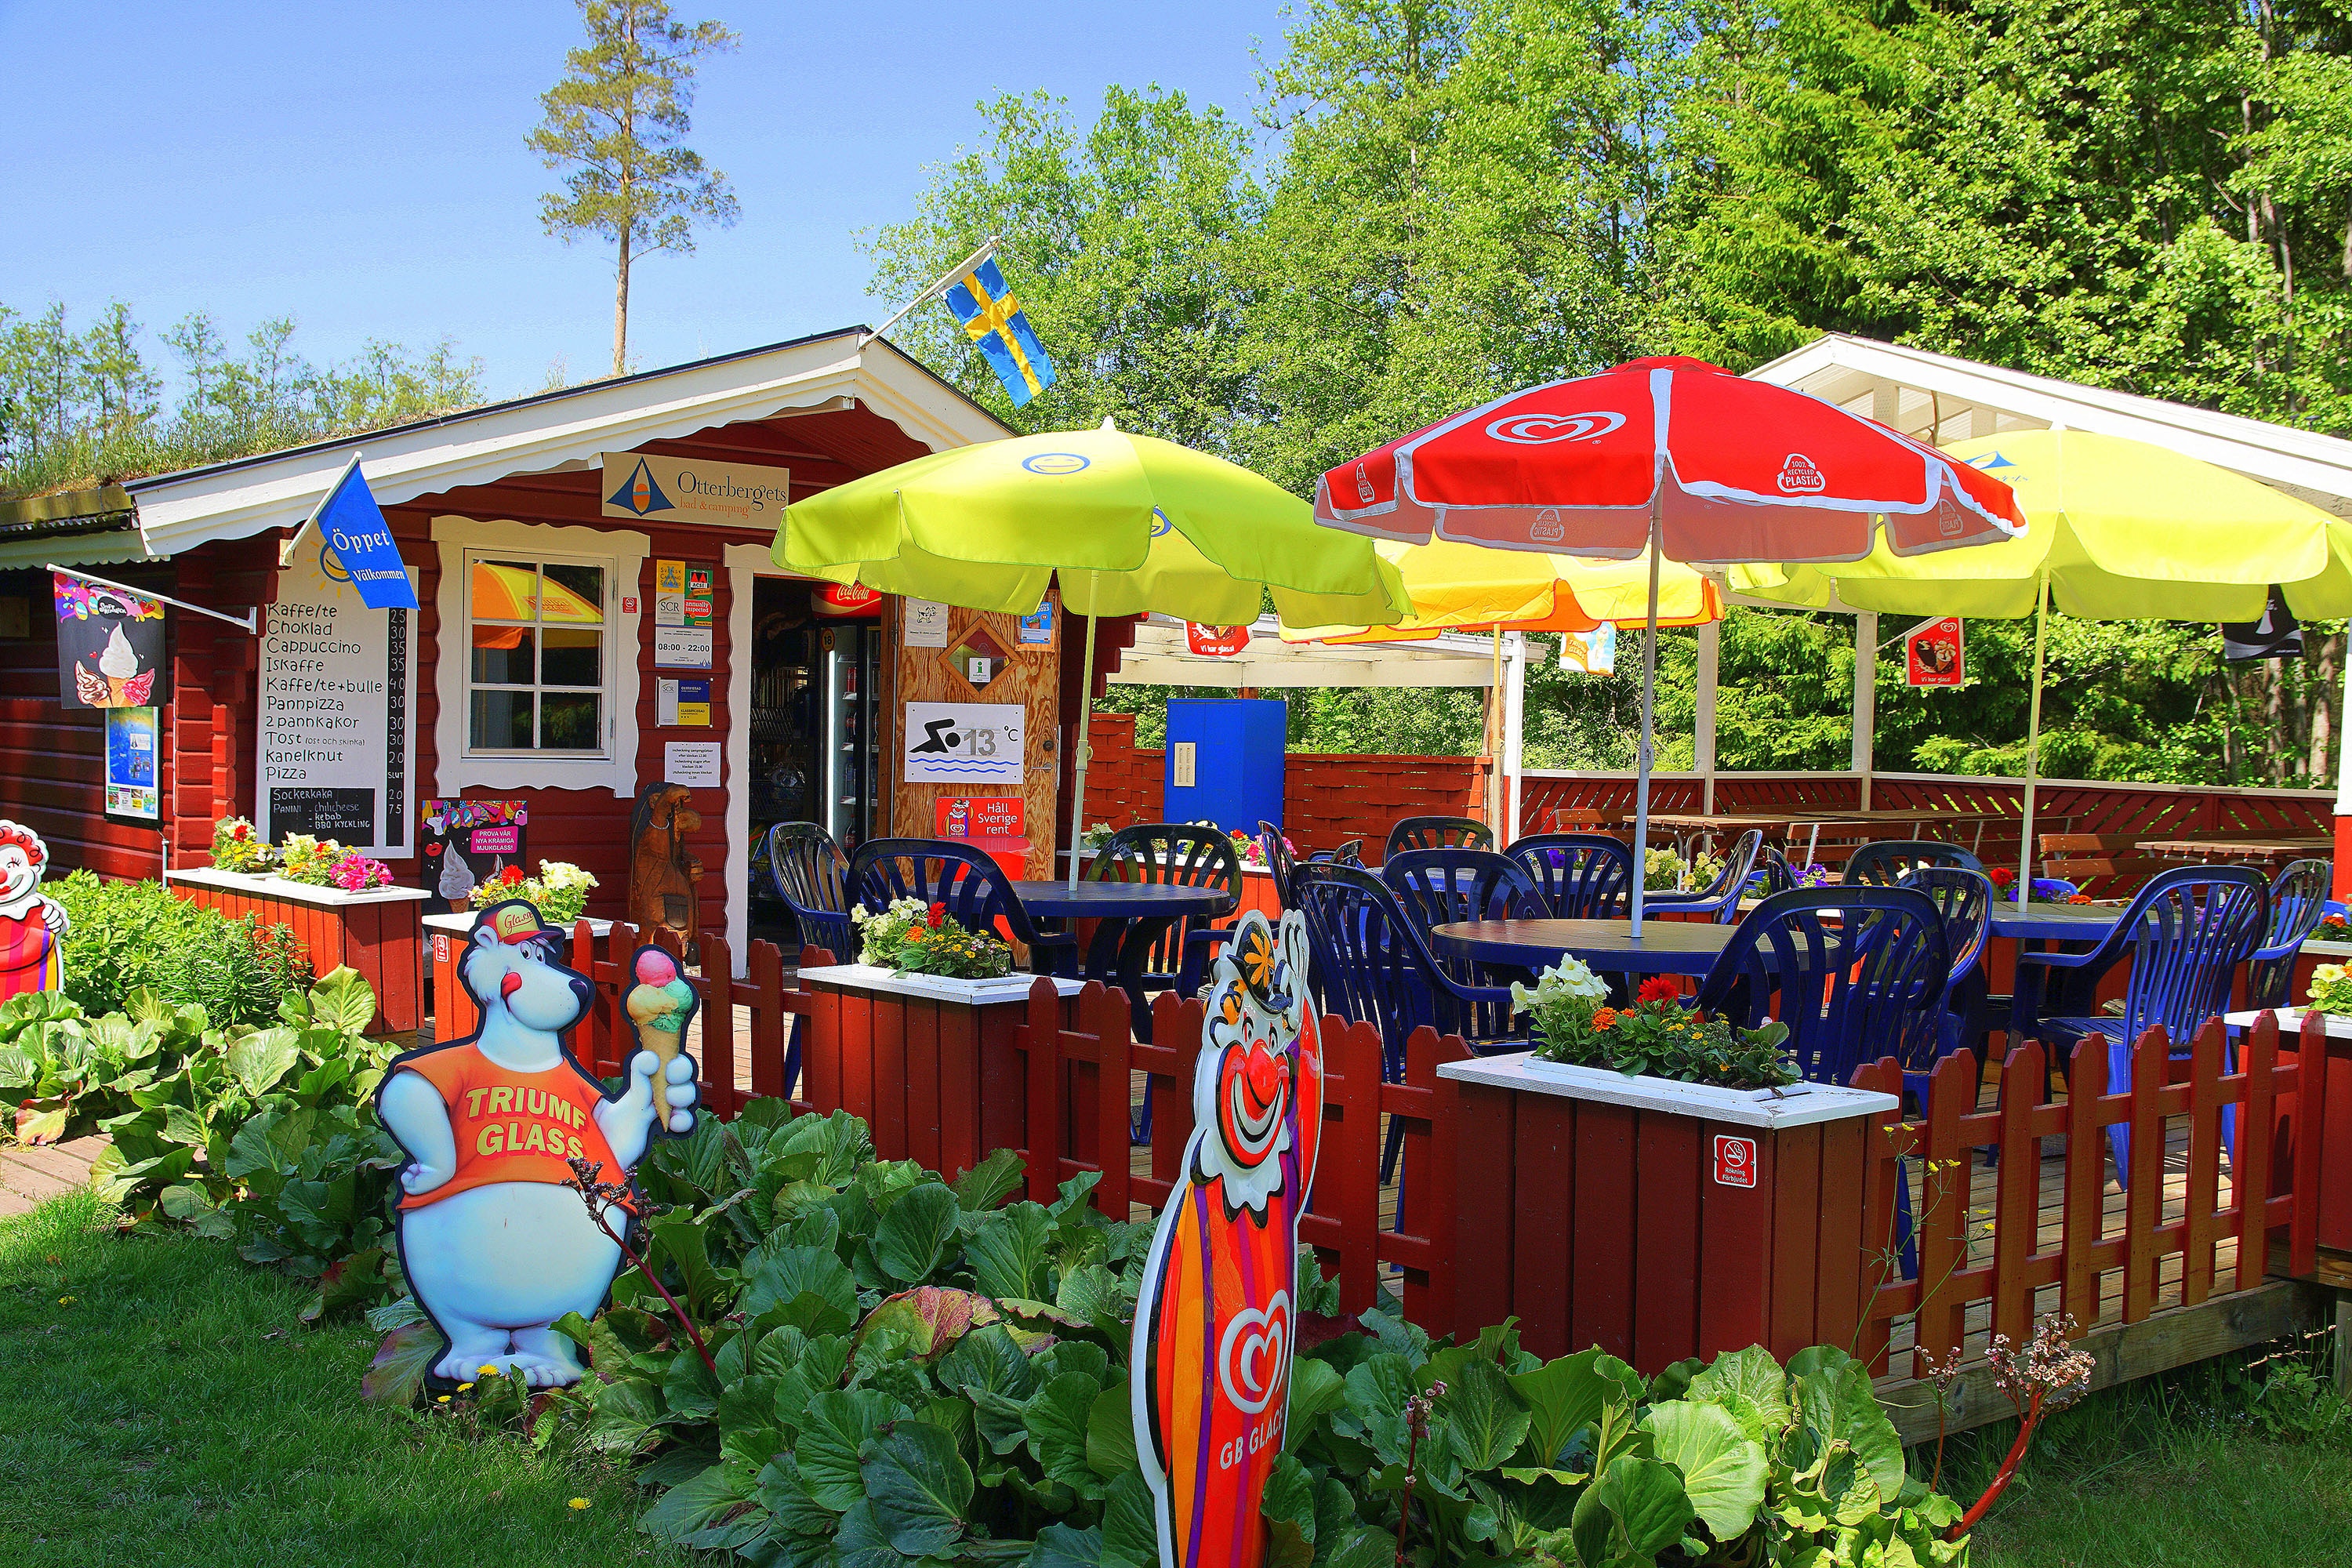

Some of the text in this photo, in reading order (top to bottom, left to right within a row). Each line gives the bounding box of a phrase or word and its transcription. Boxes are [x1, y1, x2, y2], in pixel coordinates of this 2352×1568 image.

[677, 471, 786, 511] Otterbergets
[680, 496, 697, 510] bad
[708, 504, 750, 518] camping
[332, 528, 390, 554] Öppet
[353, 568, 405, 582] Välkommen
[267, 602, 405, 623] Kaffe/te 25
[660, 601, 680, 612] SCR
[267, 619, 405, 639] Choklad 30
[267, 637, 405, 655] Cappuccino 35
[824, 636, 831, 645] 18
[266, 657, 405, 672] Iskaffe 35
[266, 677, 405, 693] Kaffe/te+bulle 40
[267, 695, 405, 712] Pannpizza 30
[266, 716, 405, 730] 2 pannkakor 30
[265, 731, 302, 746] Tost
[389, 734, 405, 746] 30
[964, 729, 996, 756] 13
[389, 752, 405, 764] 20
[265, 766, 307, 782] Pizza
[389, 789, 403, 800] 20
[314, 800, 361, 812] chilicheese
[389, 804, 402, 815] 75
[987, 801, 1009, 813] Håll
[314, 812, 342, 821] kebab
[978, 814, 1018, 826] Sverige
[986, 826, 1010, 834] rent
[466, 1086, 587, 1131] TRIUMF
[476, 1122, 585, 1160] GLASS
[1722, 1174, 1748, 1184] Förbjudet
[1725, 1167, 1745, 1177] Rökning
[1220, 1436, 1244, 1470] GB
